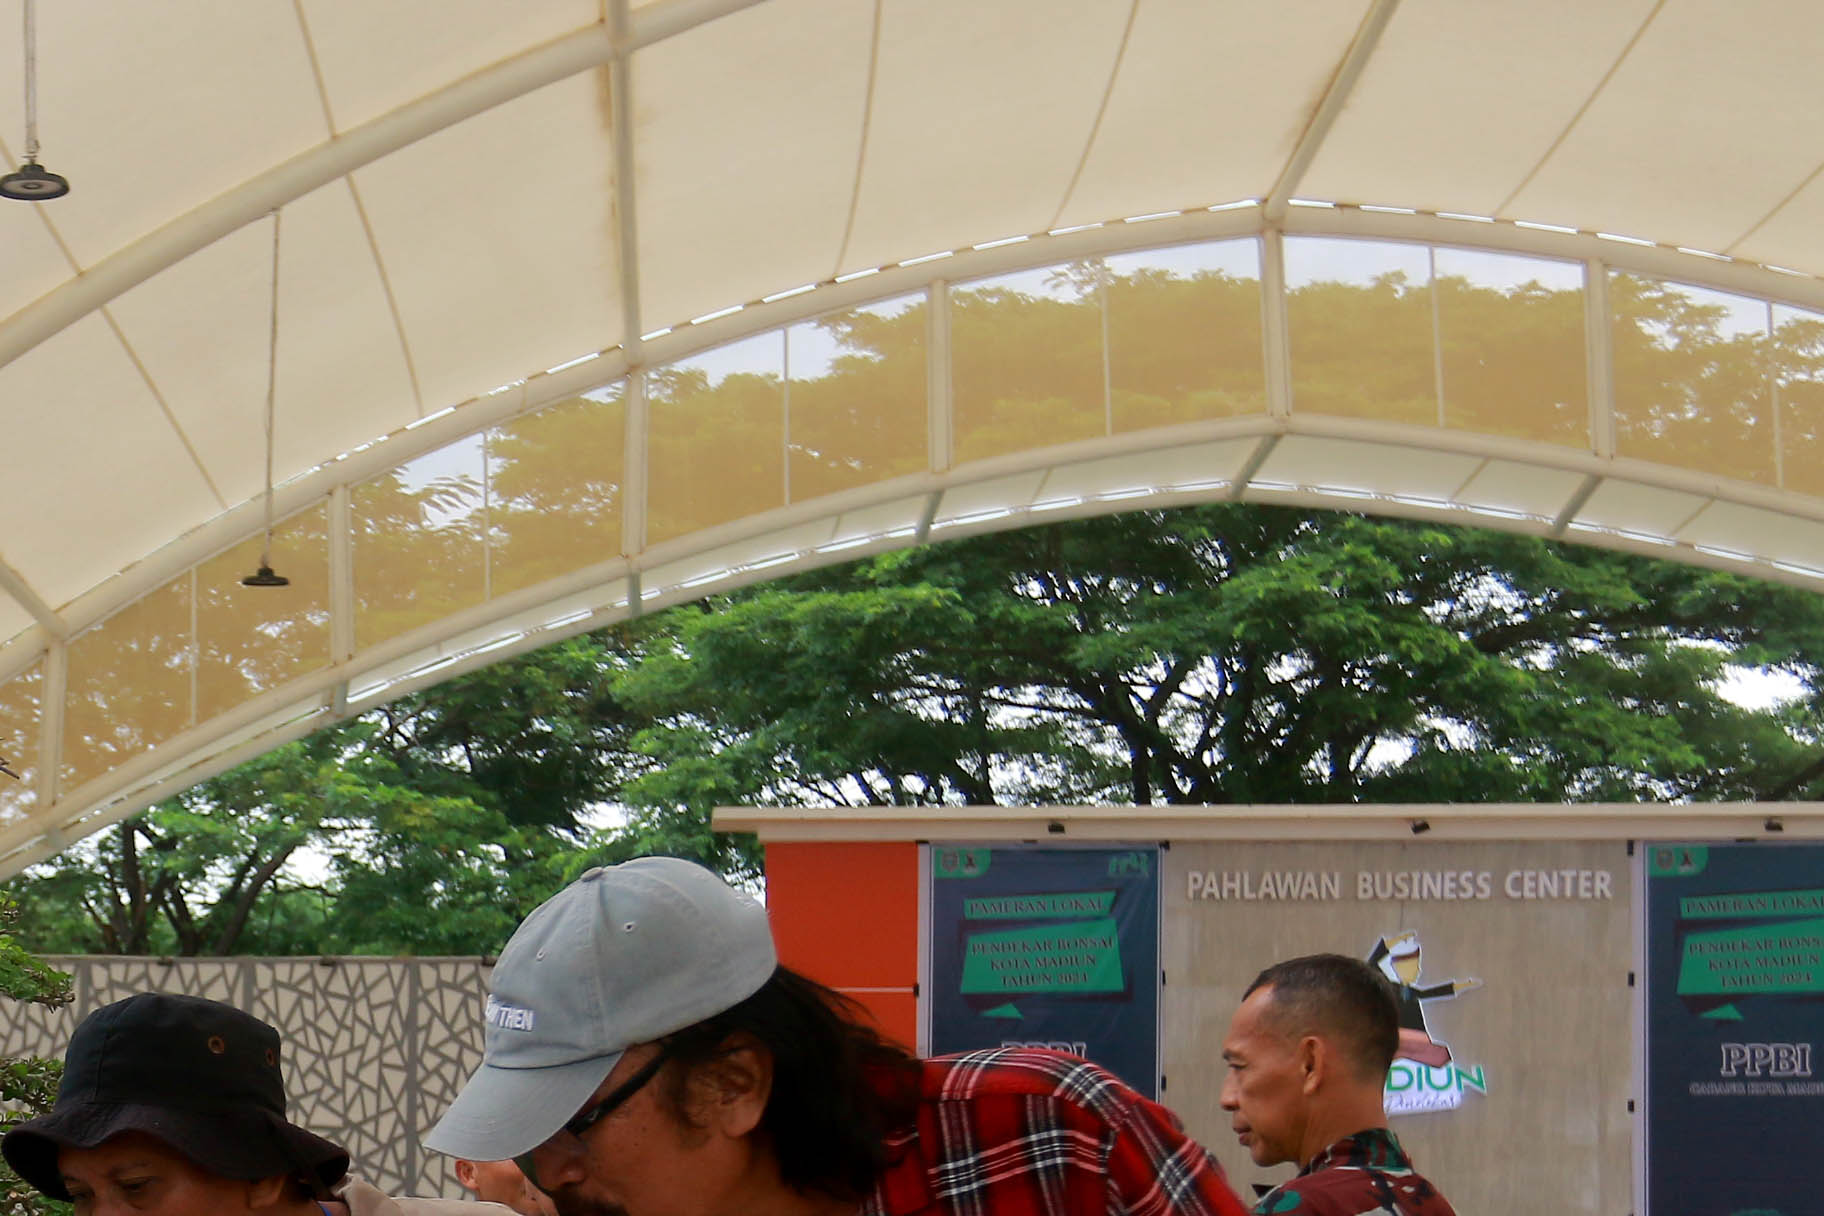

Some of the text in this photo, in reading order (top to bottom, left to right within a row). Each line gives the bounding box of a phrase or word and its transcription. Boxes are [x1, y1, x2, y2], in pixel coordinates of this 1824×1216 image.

[1187, 870, 1614, 900] PAHLAWAN BUSINESS CENTER
[969, 896, 1107, 915] PAMERAN LOKAL
[1686, 897, 1768, 913] PAMERAN
[971, 935, 1114, 956] PENDEKAR BONSAI
[990, 954, 1097, 972] KOTA MADIUN
[1001, 973, 1052, 987] TAHUN
[1720, 1042, 1812, 1077] PPBI
